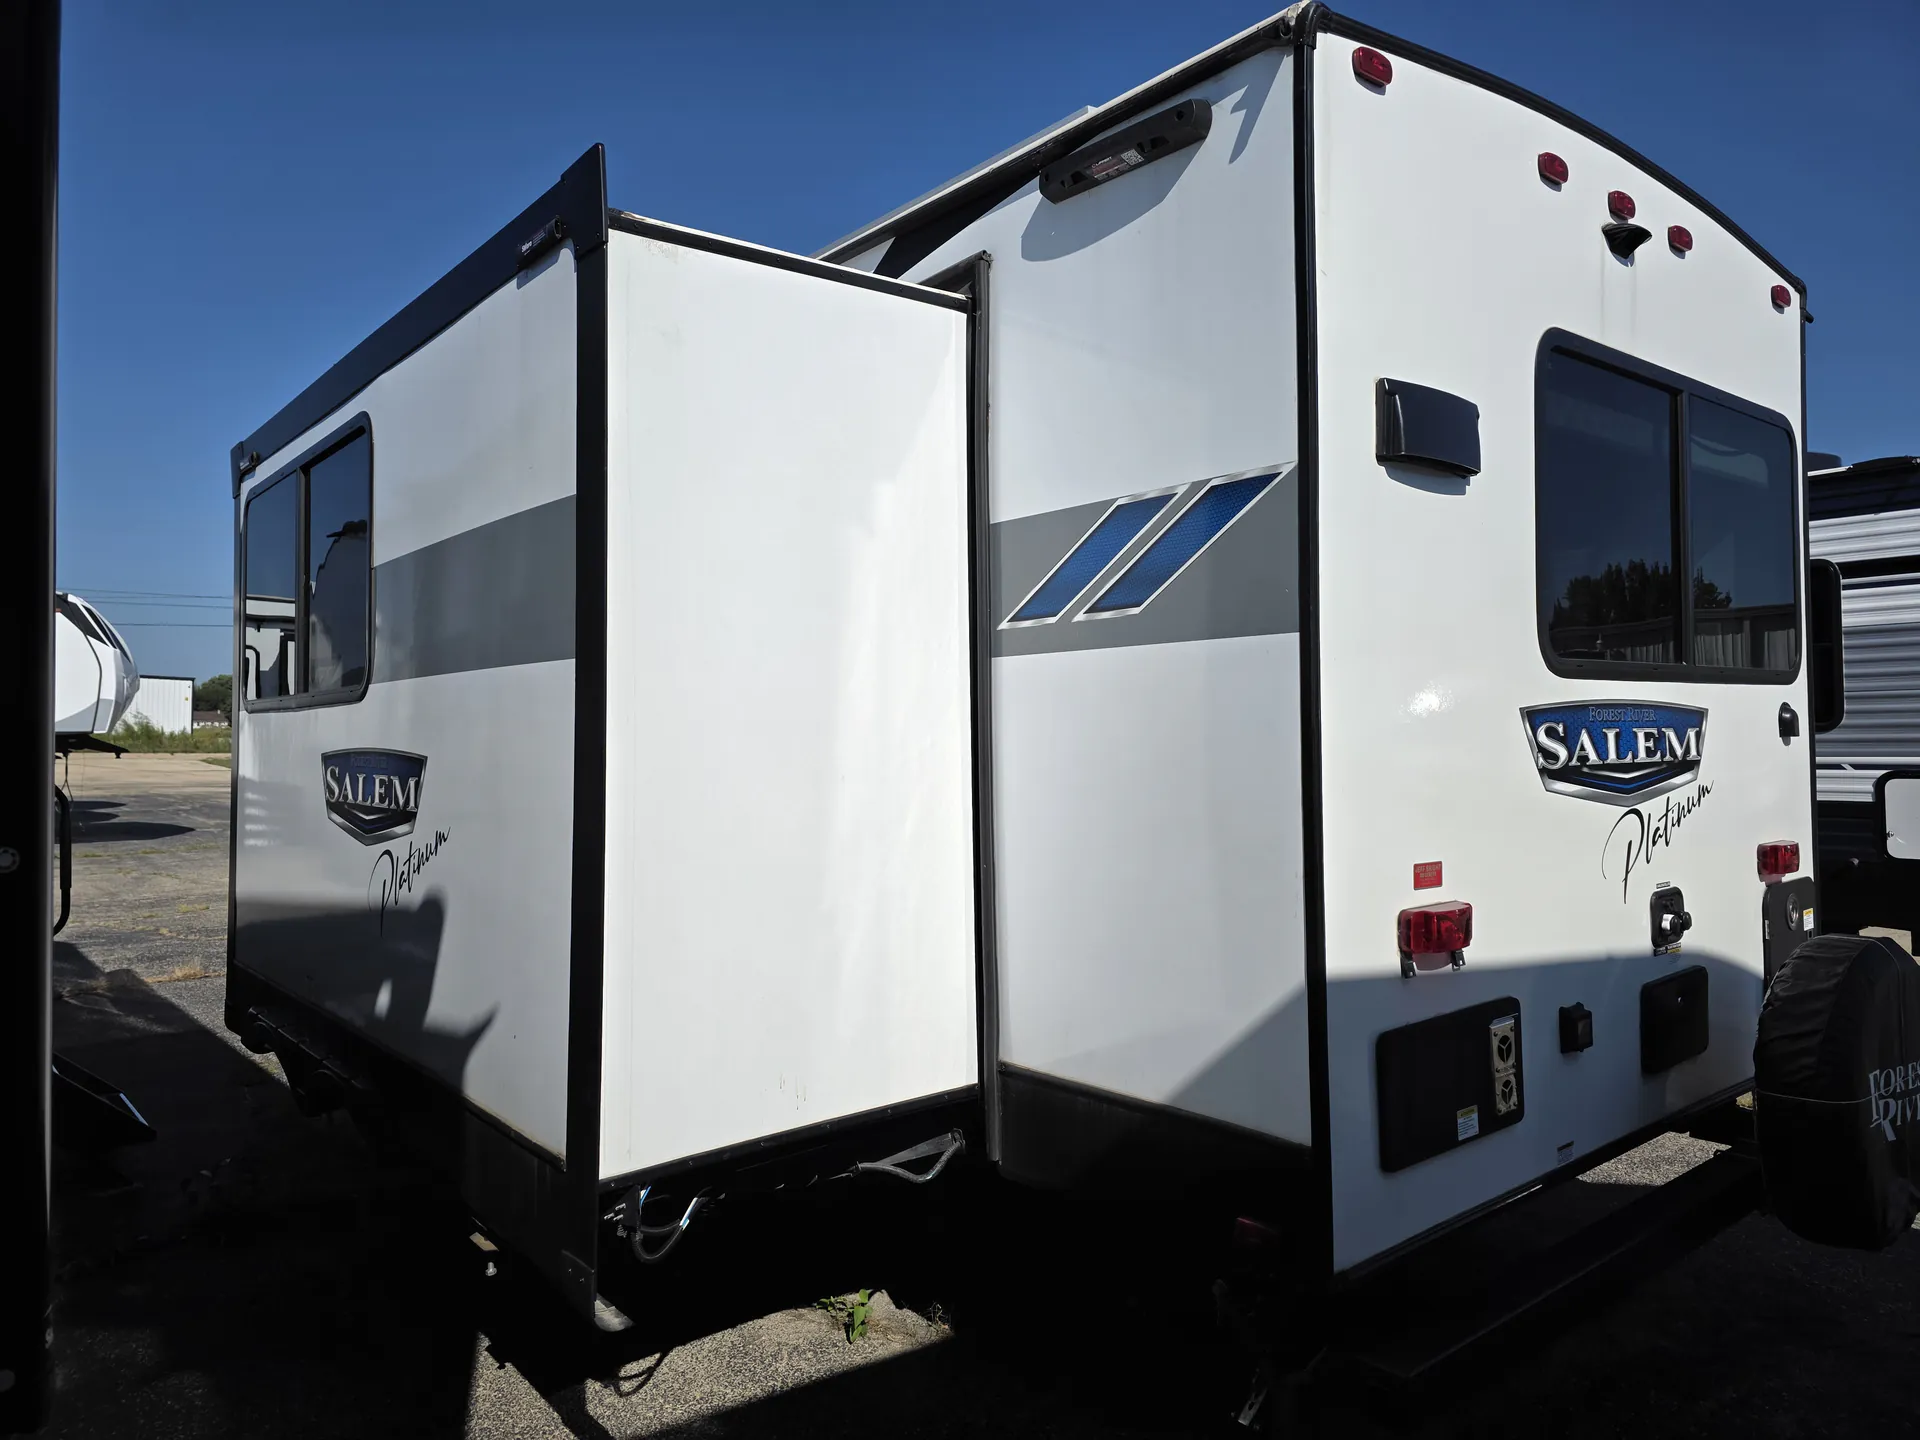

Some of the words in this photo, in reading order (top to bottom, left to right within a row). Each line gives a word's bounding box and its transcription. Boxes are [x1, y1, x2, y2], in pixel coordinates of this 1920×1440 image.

[1589, 706, 1625, 721] FOREST
[1626, 706, 1656, 721] RIVER
[1536, 721, 1701, 770] SALEM
[326, 766, 418, 813] SALEM
[1602, 780, 1714, 904] Platinum
[368, 826, 451, 939] Platinum
